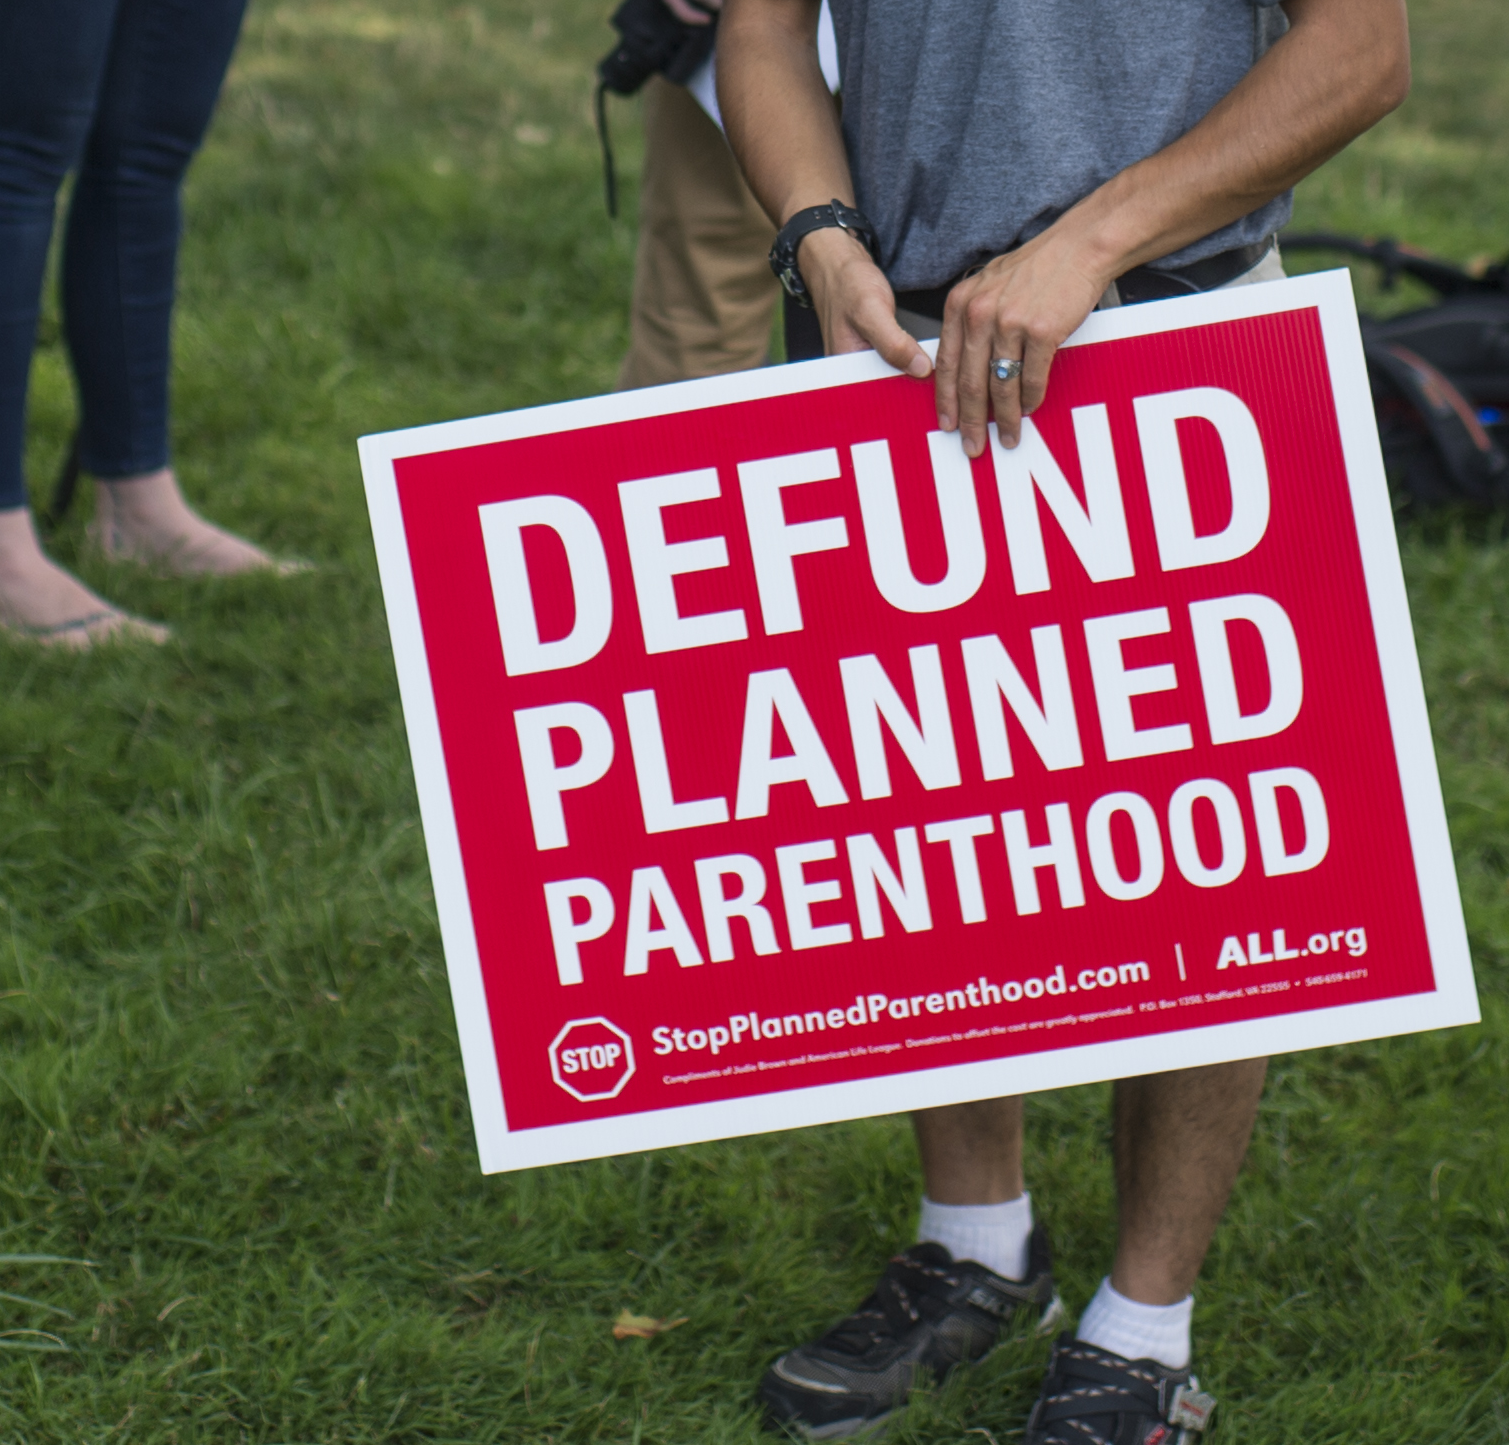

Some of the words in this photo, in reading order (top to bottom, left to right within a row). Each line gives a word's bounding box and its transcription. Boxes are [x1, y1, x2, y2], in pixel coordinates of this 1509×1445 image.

[477, 386, 1270, 677] DEFUND
[513, 593, 1303, 851] PLANNED
[543, 766, 1330, 986] PARENTHOOD
[561, 1043, 621, 1073] STOP
[651, 961, 1150, 1055] StopPlannedParenthood.com
[1216, 927, 1367, 970] ALL.org
